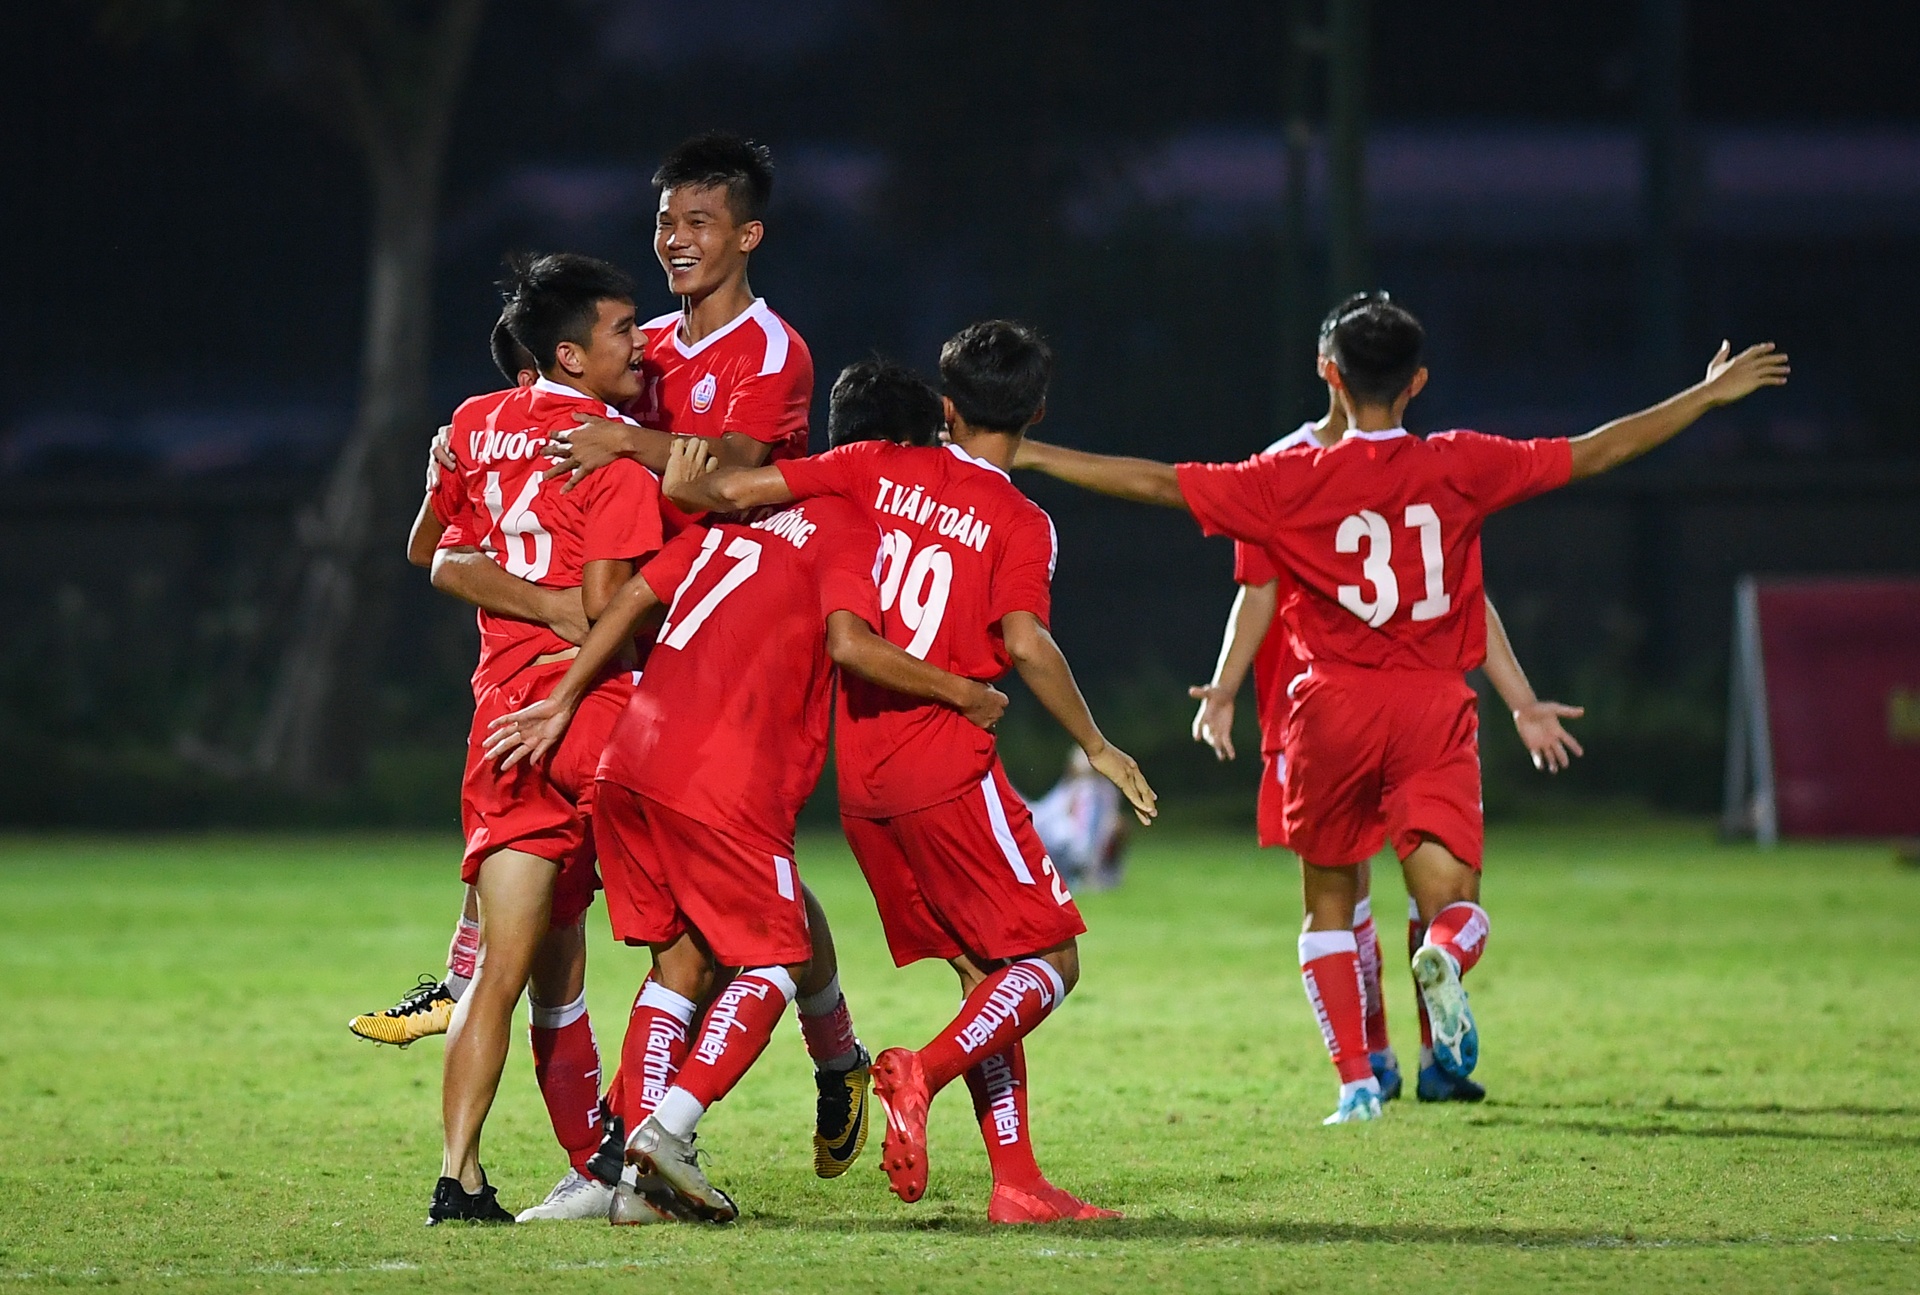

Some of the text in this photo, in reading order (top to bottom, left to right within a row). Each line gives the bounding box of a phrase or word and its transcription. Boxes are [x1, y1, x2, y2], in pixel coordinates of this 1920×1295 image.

[1335, 503, 1451, 629] 31
[1041, 853, 1072, 906] 2
[980, 1052, 1021, 1146] anhniên
